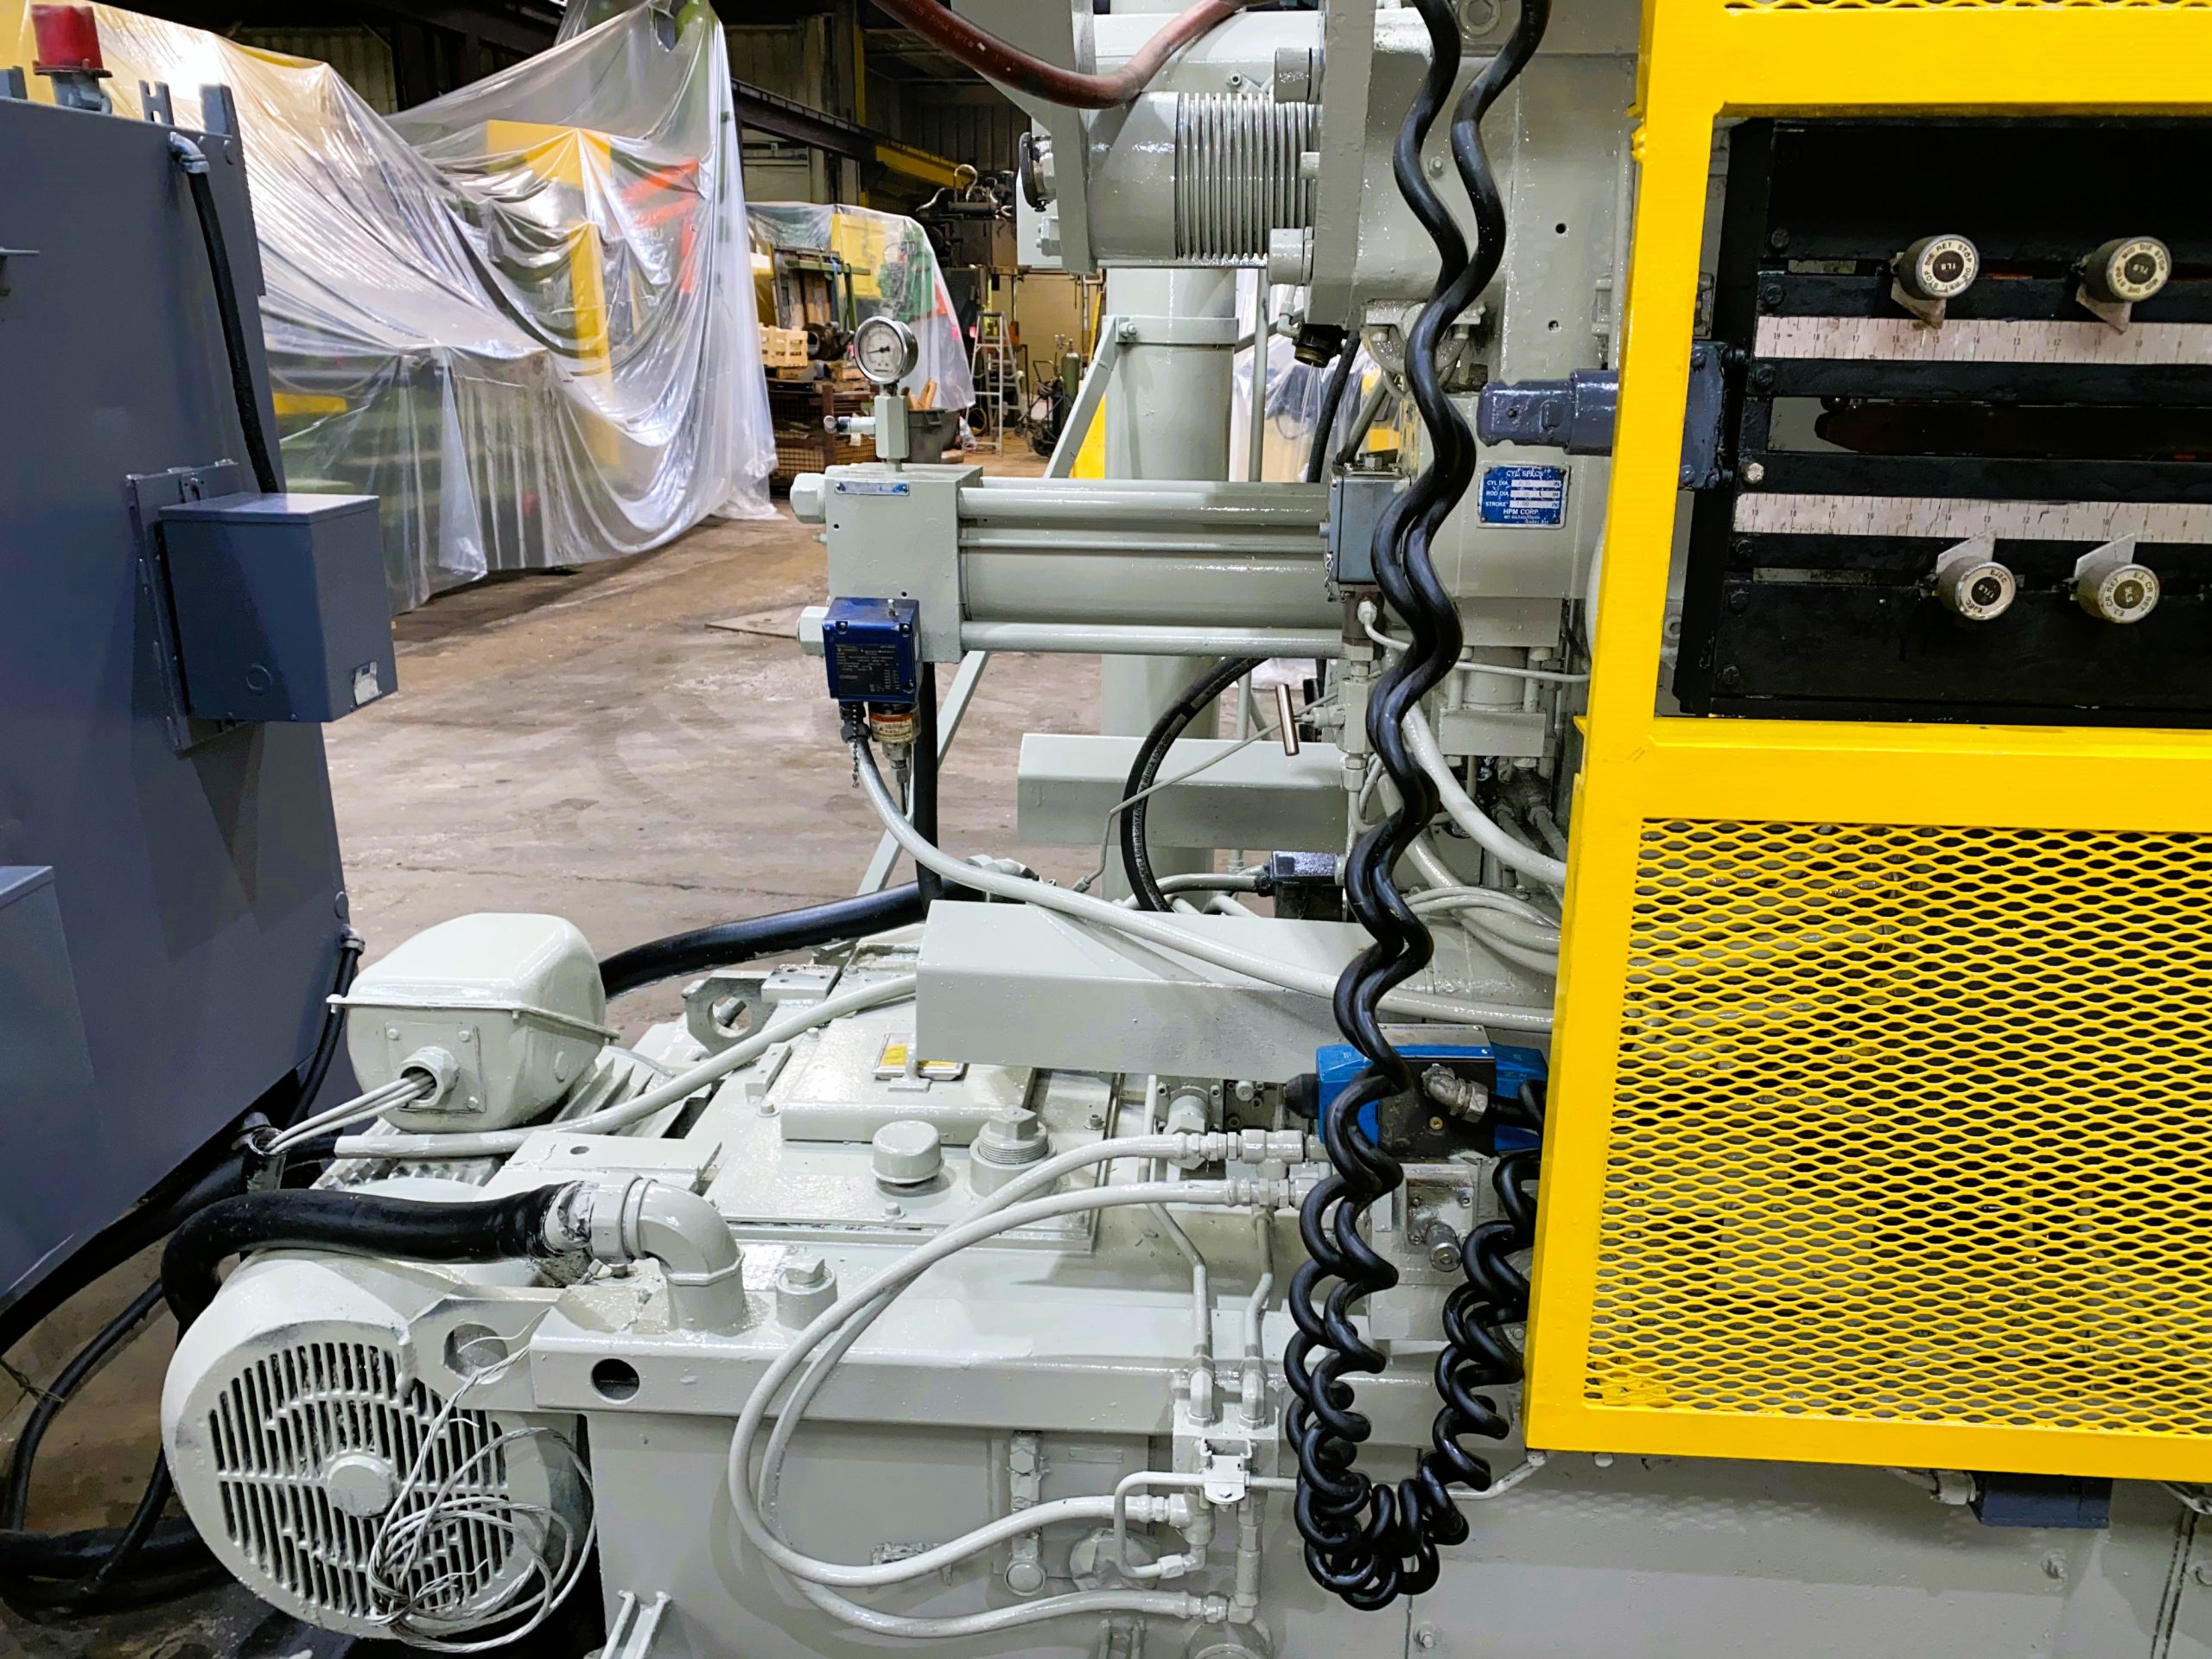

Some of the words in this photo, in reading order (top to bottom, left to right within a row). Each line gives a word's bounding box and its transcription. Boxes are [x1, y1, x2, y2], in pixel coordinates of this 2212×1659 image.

[1958, 244, 1973, 263] STOP
[1924, 271, 1938, 289] STOP
[2145, 582, 2153, 593] CR
[2105, 595, 2113, 607] CR
[1145, 761, 1156, 776] USA
